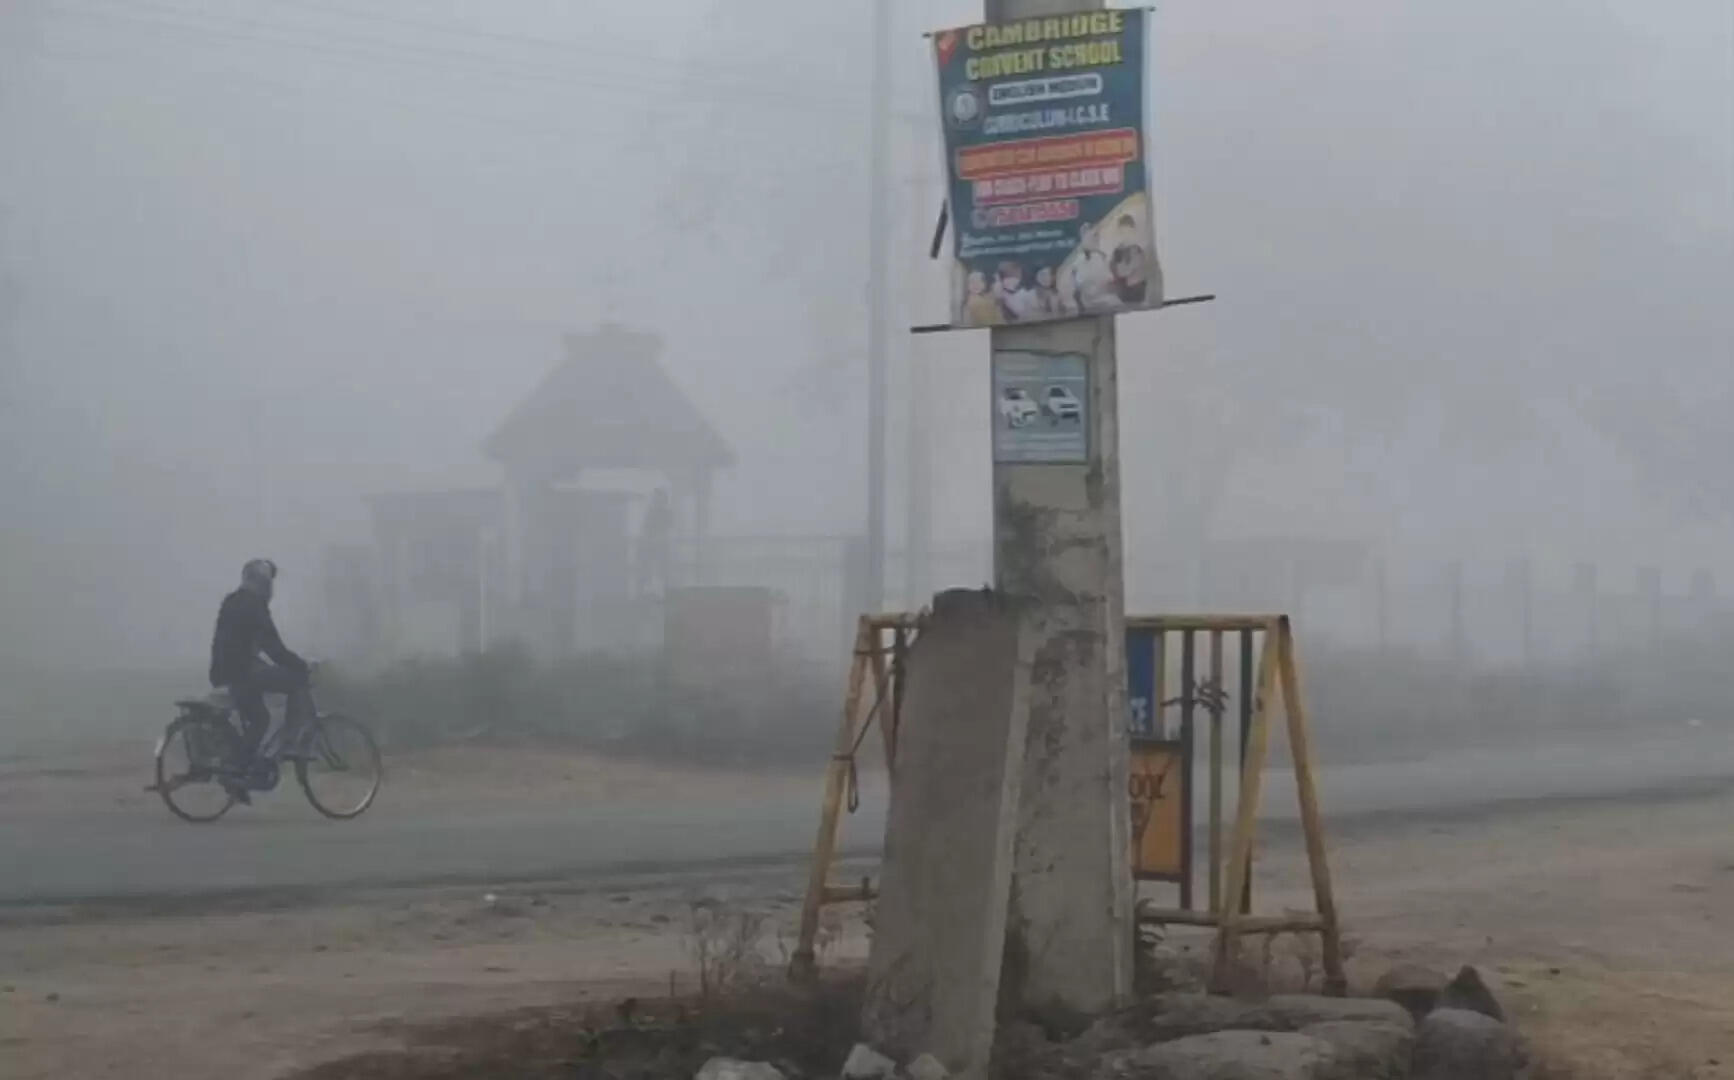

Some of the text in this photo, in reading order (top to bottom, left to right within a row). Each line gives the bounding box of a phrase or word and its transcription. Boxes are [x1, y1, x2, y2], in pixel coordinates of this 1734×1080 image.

[968, 10, 1125, 49] CAMBRIDGE
[966, 40, 1123, 80] CONVENT SCHOOL
